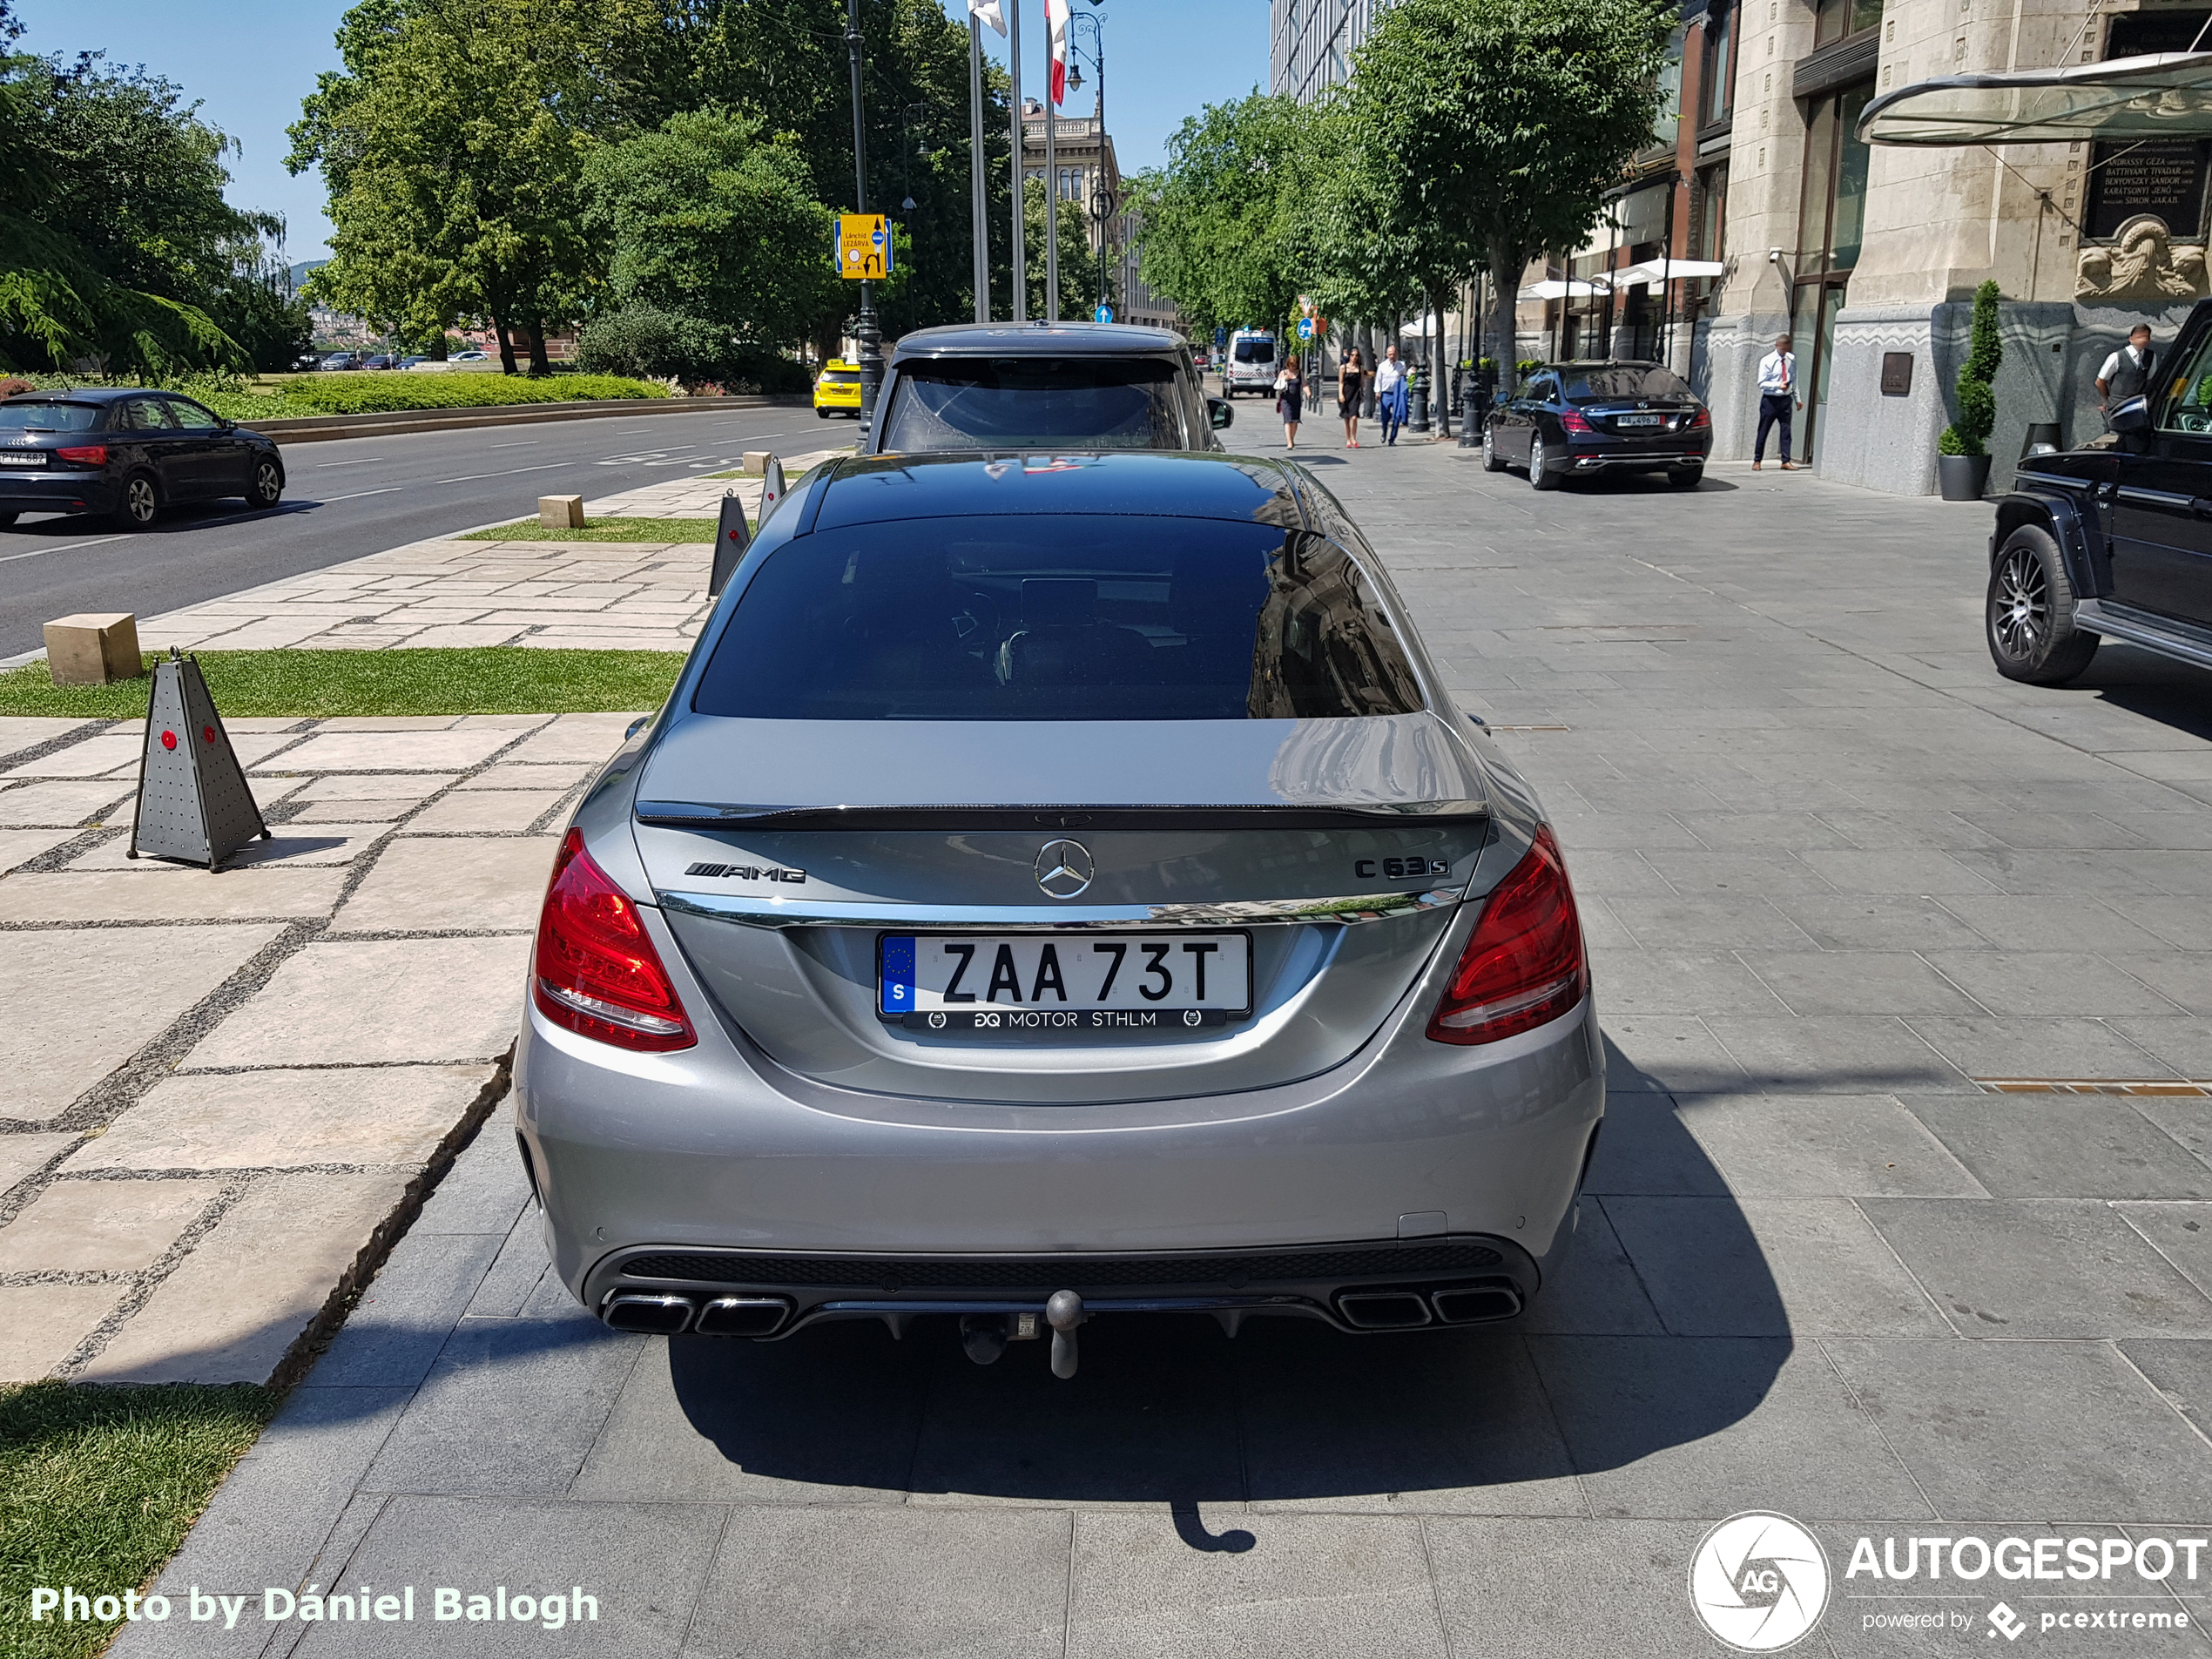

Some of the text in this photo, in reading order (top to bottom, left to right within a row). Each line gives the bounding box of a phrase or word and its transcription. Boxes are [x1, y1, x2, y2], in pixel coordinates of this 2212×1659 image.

[943, 942, 1218, 1002] ZAA 73T
[893, 983, 905, 1001] S
[1009, 1012, 1078, 1027] MOTOR
[1092, 1011, 1156, 1027] STHLM
